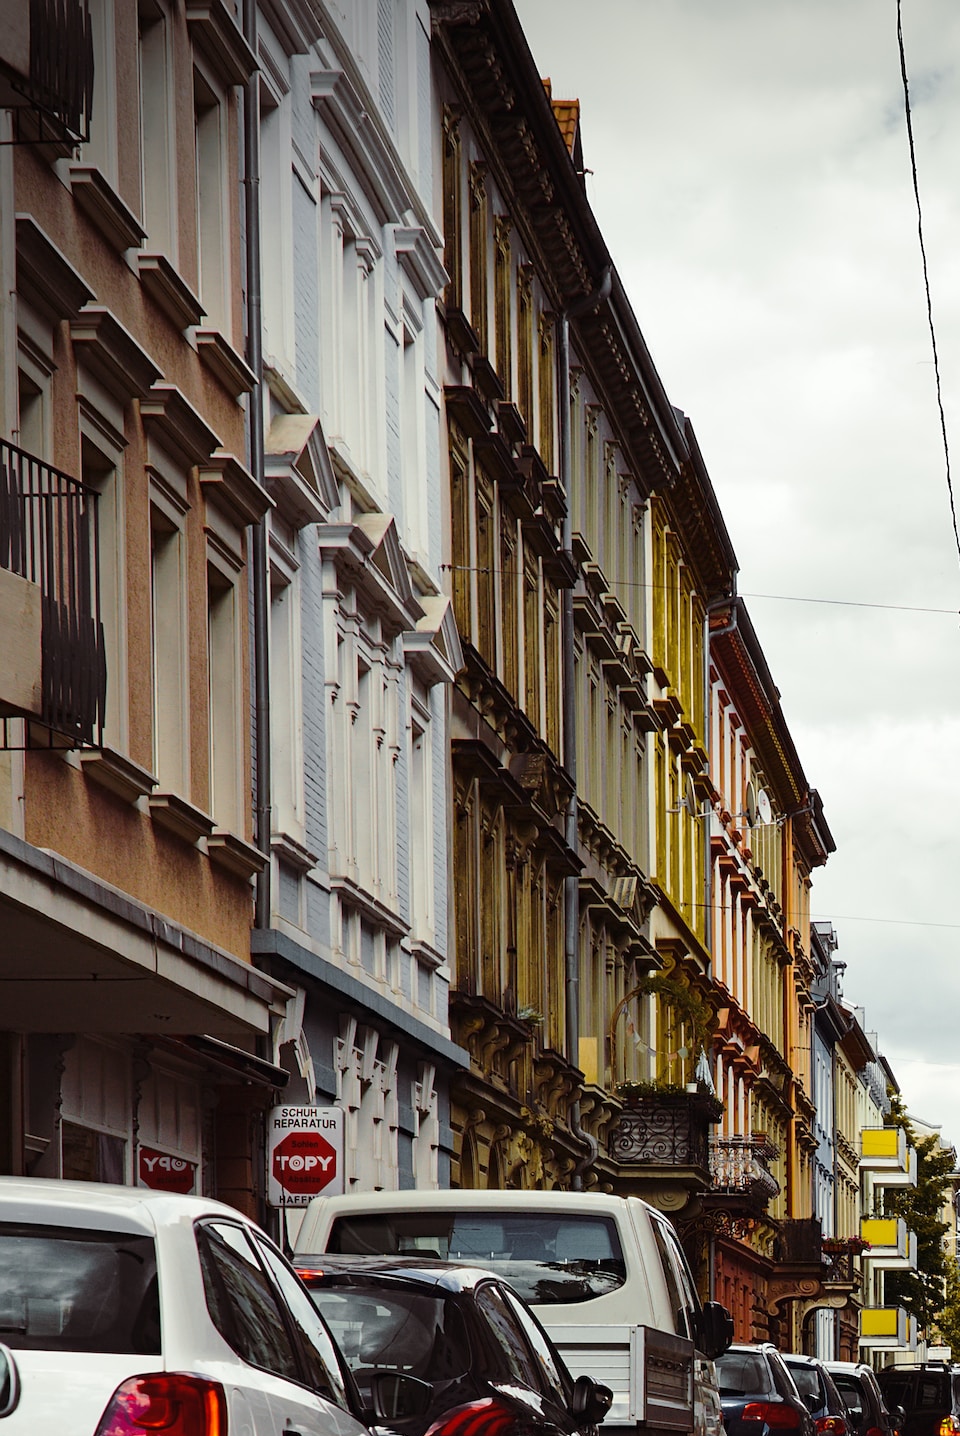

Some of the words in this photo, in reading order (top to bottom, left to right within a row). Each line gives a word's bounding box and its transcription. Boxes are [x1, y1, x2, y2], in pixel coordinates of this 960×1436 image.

[281, 1108, 317, 1117] SCHUH
[273, 1119, 336, 1129] REPARATUR
[275, 1155, 333, 1171] TOPY
